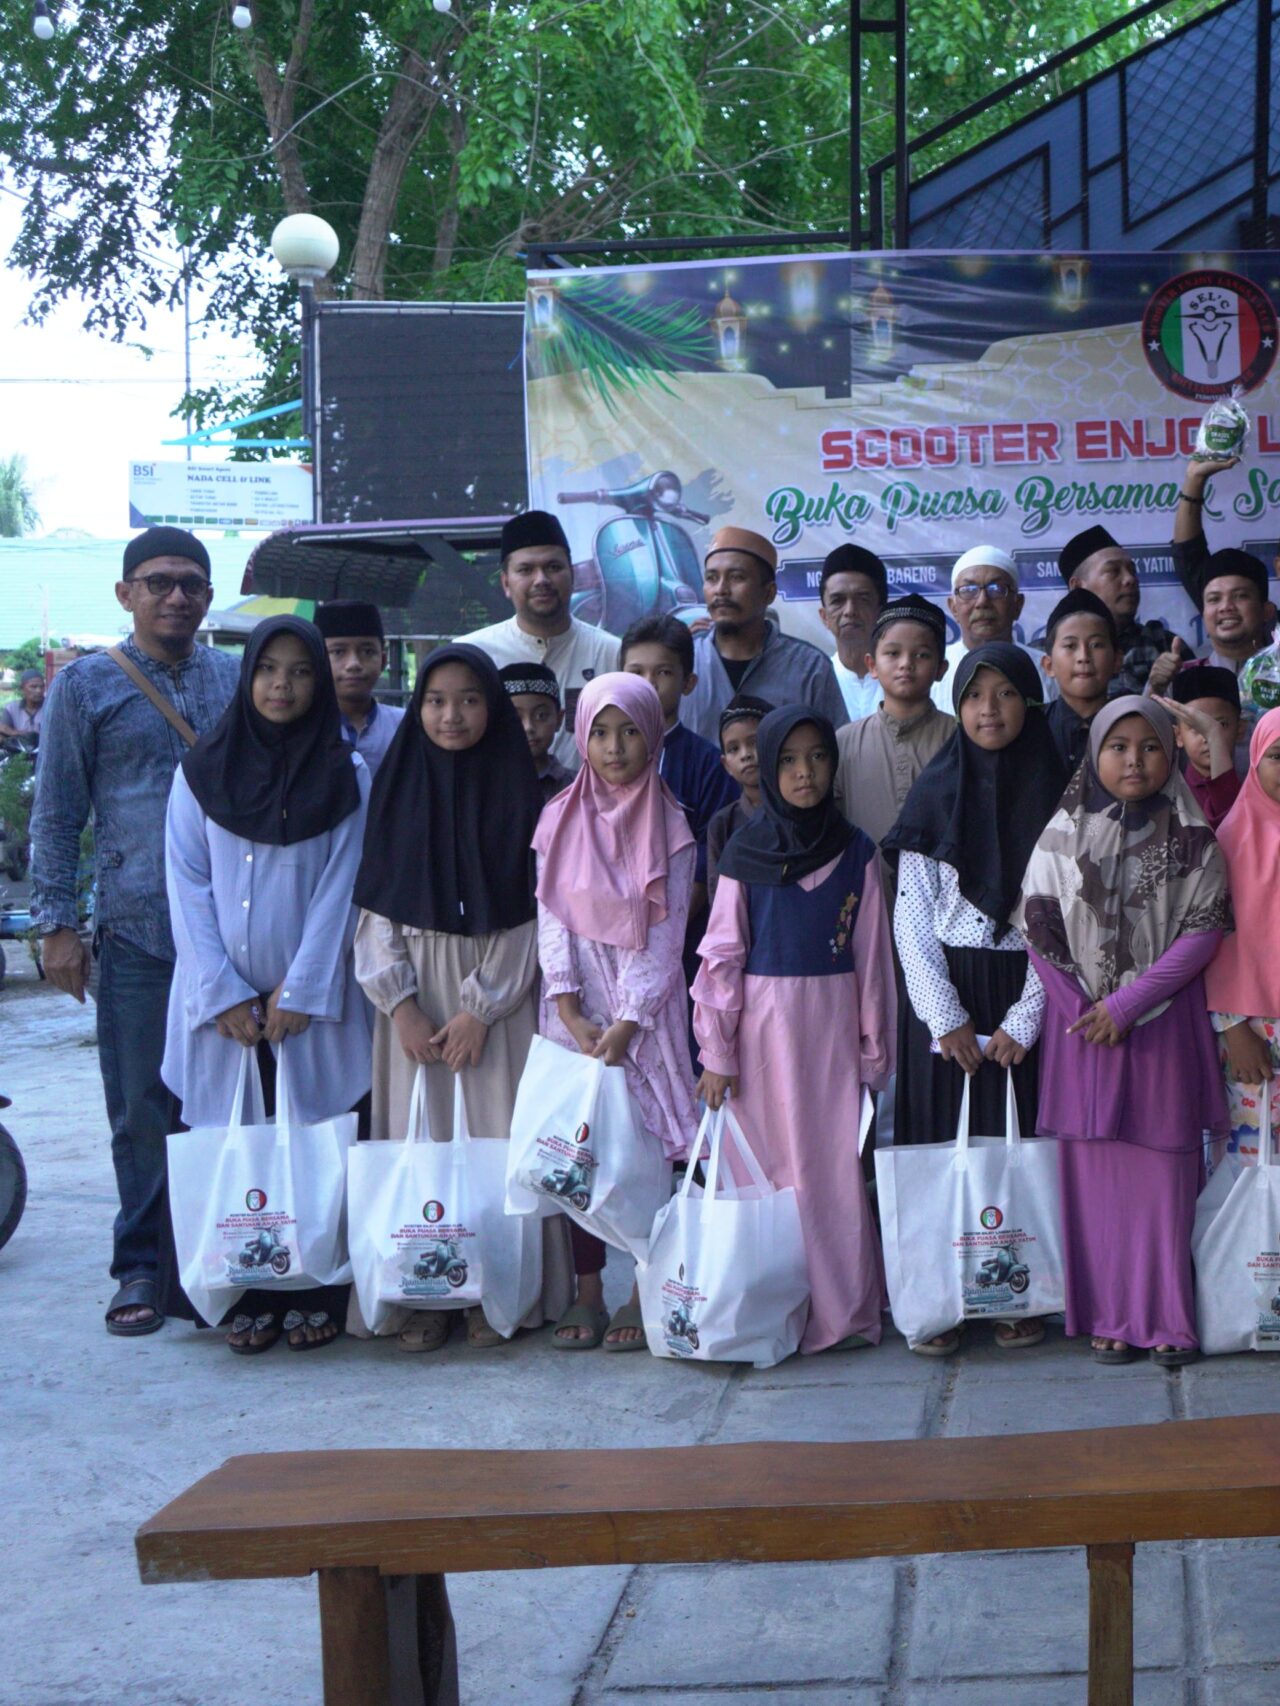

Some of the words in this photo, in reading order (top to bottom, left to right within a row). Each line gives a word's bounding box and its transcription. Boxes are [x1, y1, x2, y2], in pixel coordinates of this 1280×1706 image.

[1189, 292, 1230, 310] SEL'C
[823, 424, 1059, 470] SCOOTER
[1076, 419, 1202, 460] ENJO
[133, 464, 154, 477] BSI
[187, 474, 213, 482] NADA
[215, 475, 237, 483] CELL
[249, 476, 271, 484] LINK
[766, 482, 870, 545] Buka
[881, 482, 1002, 530] Puasa
[1014, 476, 1181, 534] Bersama
[887, 567, 936, 583] BARENG
